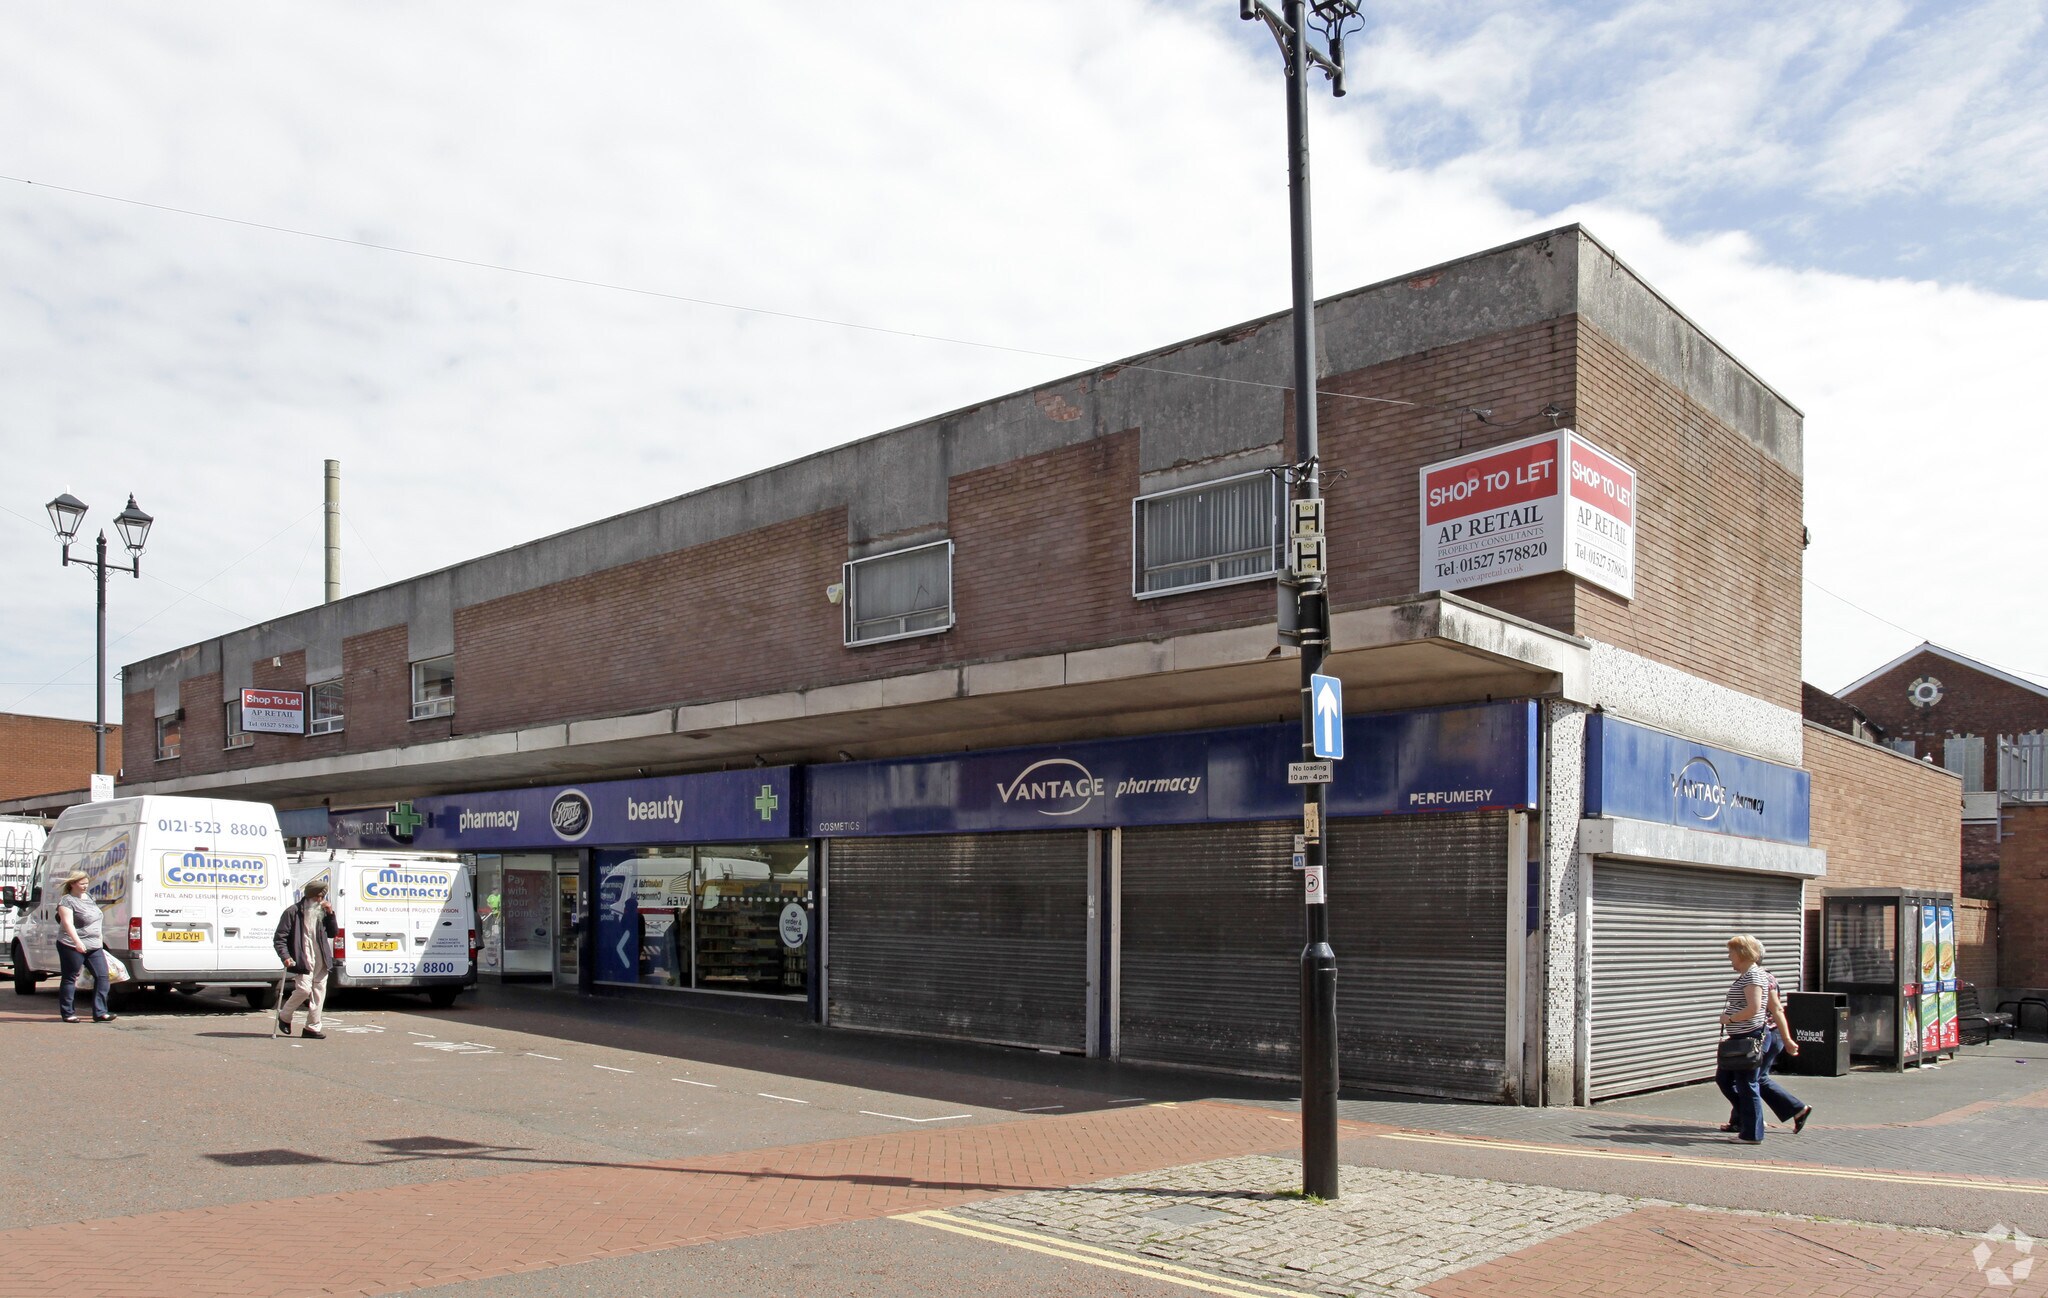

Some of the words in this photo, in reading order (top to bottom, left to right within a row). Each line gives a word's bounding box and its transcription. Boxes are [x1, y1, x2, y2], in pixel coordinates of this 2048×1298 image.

[1430, 479, 1480, 507] SHOP
[1483, 470, 1510, 493] TO
[1516, 459, 1554, 485] LET
[1572, 460, 1600, 489] SHOP
[1601, 475, 1615, 498] TO
[1616, 484, 1631, 508] LET
[1438, 523, 1462, 545] AP
[1469, 505, 1544, 537] RETAIL
[1577, 505, 1592, 526] AP
[1594, 513, 1627, 546] RETAIL
[1438, 540, 1480, 557] PROPERTY
[1481, 527, 1544, 548] CONSULTANTS
[1460, 553, 1494, 573] 01527
[1498, 541, 1548, 565] 578820
[1455, 564, 1524, 585] www.apretail.co.uk
[1607, 558, 1629, 580] 578820
[246, 694, 271, 705] Shop
[272, 696, 284, 705] To
[285, 697, 300, 706] Let
[265, 710, 294, 718] RETAIL
[997, 777, 1105, 803] VANTAGE
[1115, 776, 1201, 798] pharmacy
[1410, 789, 1493, 806] PERFUMERY
[1670, 773, 1726, 805] VANTAGE
[554, 801, 581, 827] Boots
[628, 795, 683, 824] beauty
[158, 819, 221, 834] 0121-523
[231, 823, 267, 837] 8800
[347, 822, 374, 836] CANCER
[459, 808, 520, 833] pharmacy
[819, 821, 860, 833] COSMETICS
[183, 852, 264, 870] MIDLAND
[167, 866, 264, 885] CONTRACTS
[379, 869, 448, 885] MIDLAND
[507, 874, 526, 887] Pay
[366, 882, 449, 898] CONTRACTS
[507, 886, 528, 896] with
[507, 898, 529, 909] your
[508, 909, 538, 919] points
[161, 932, 181, 940] AJ12
[182, 932, 200, 940] GYH
[363, 962, 416, 974] 0121-523
[423, 962, 454, 973] 8800
[1796, 1028, 1824, 1037] Walsall
[1797, 1036, 1825, 1044] COUNCIL
